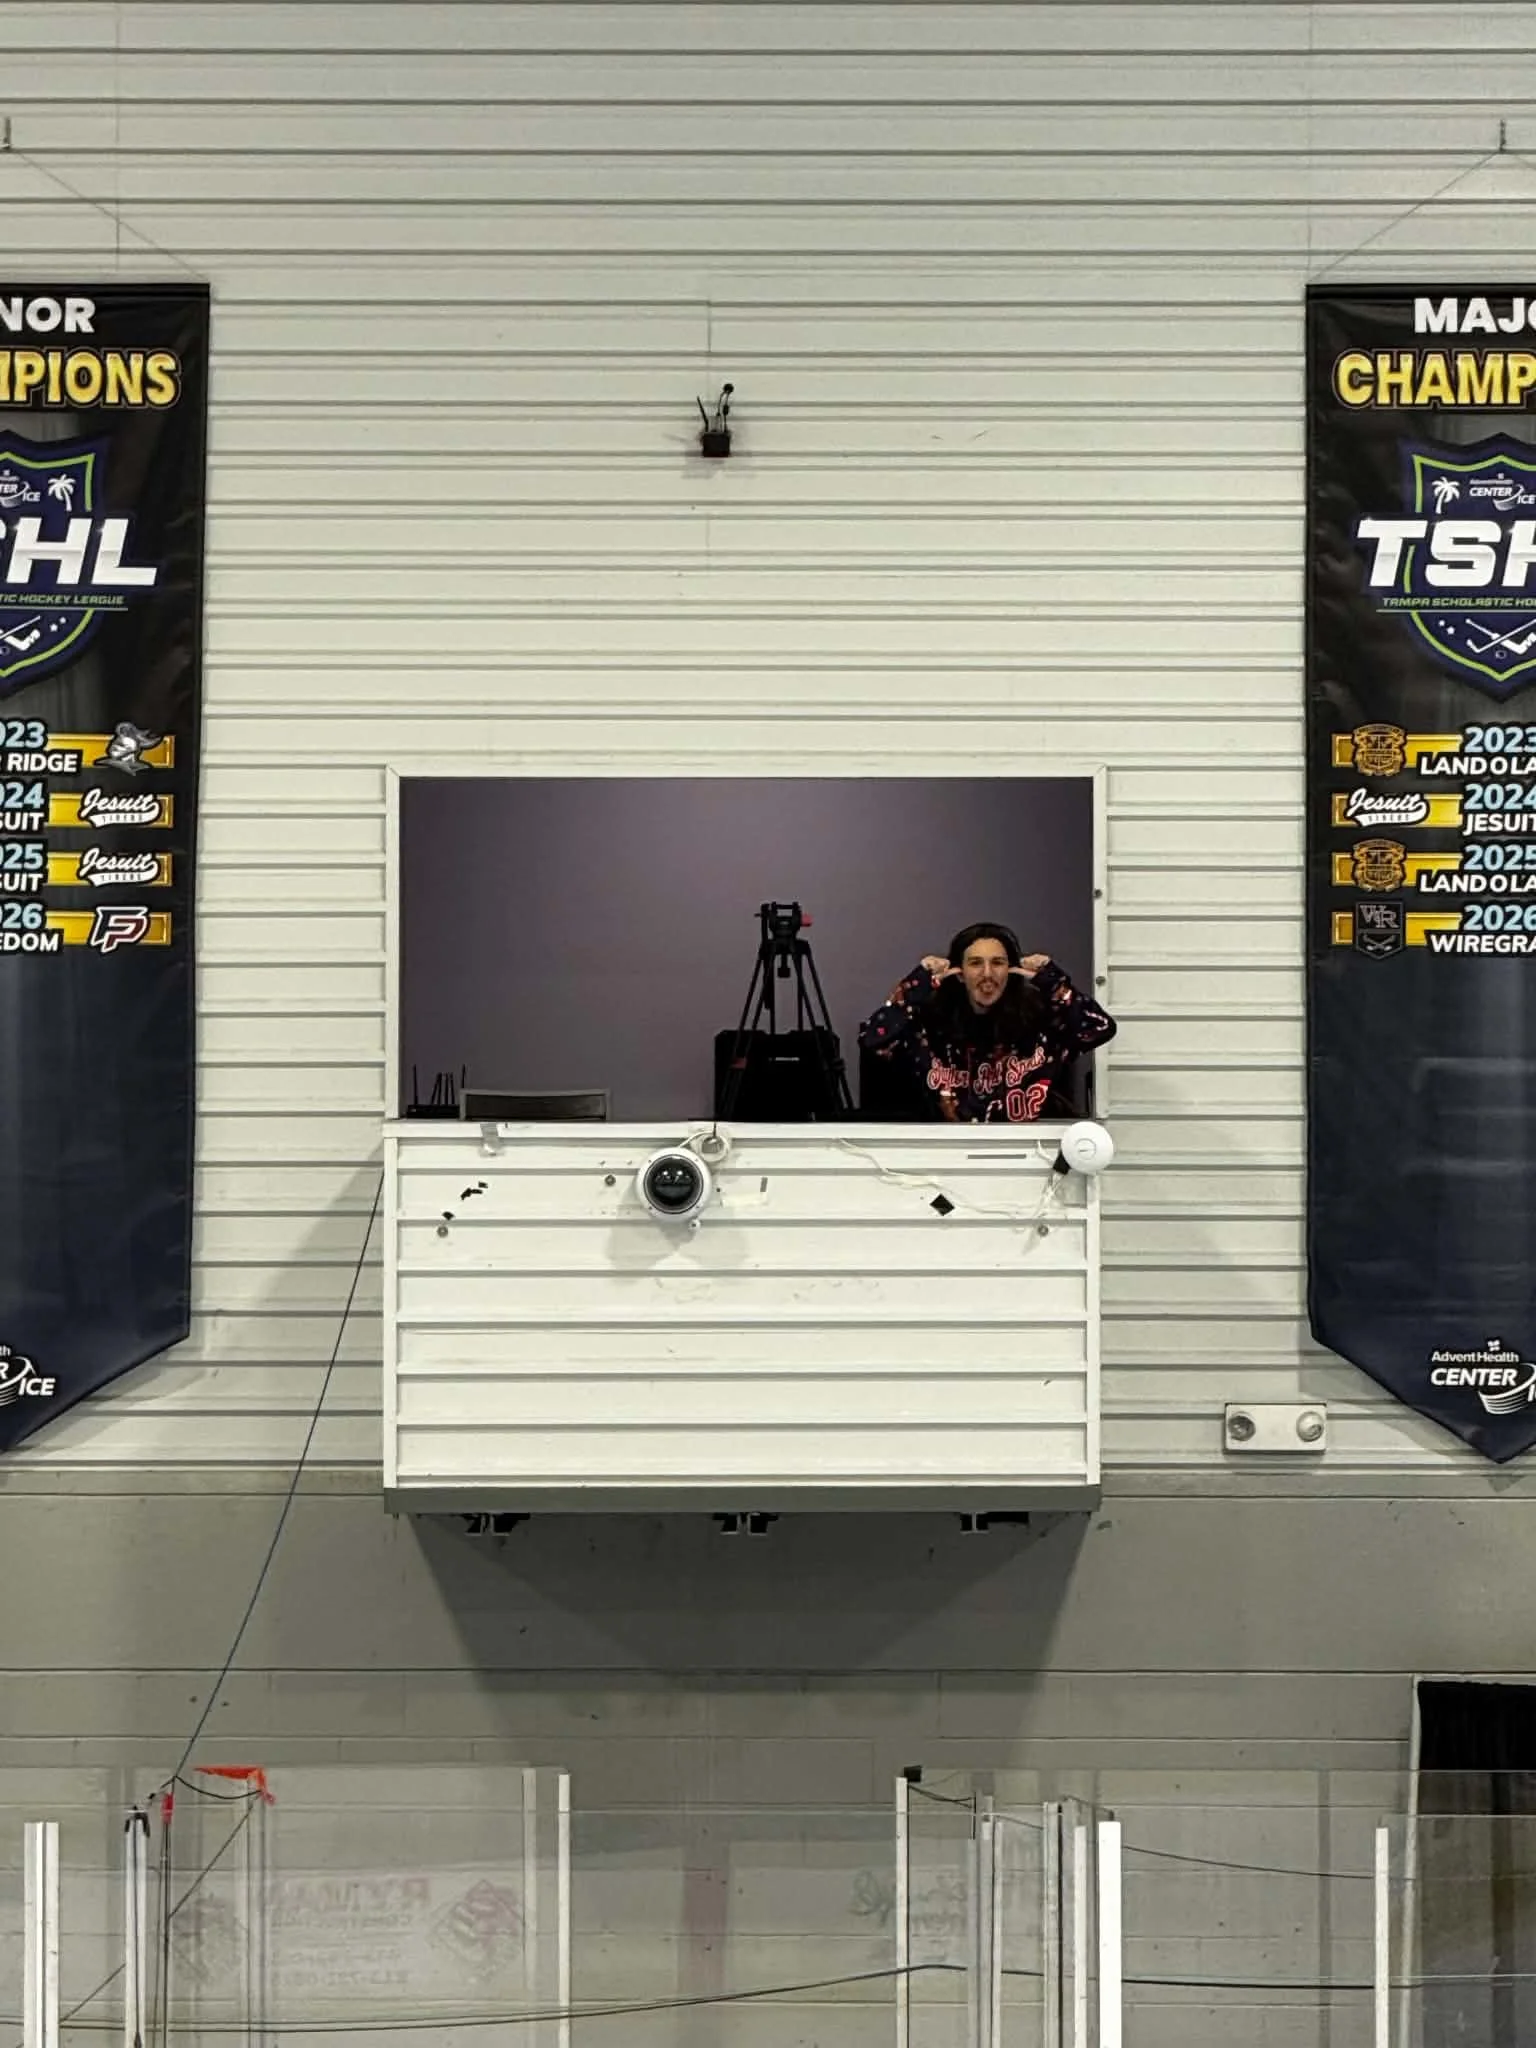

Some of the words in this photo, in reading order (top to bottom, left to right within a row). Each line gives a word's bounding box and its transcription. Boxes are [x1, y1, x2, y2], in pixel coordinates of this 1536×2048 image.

[0, 297, 96, 332] NOR
[1414, 297, 1536, 333] MAJ
[0, 351, 178, 405] PIONS
[1337, 353, 1536, 405] CHAMP
[1470, 487, 1513, 497] CENTER
[1517, 494, 1536, 504] ICE
[0, 517, 157, 586] HL
[18, 594, 71, 604] HOCKEY
[73, 595, 125, 605] LEAGUE
[1382, 597, 1430, 607] TAMPA
[1432, 597, 1514, 607] SCHOLASTIC
[1515, 597, 1536, 607] HO
[1464, 726, 1536, 752] 2023
[8, 753, 78, 772] RIDGE
[1421, 756, 1487, 775] LAND
[0, 782, 44, 808] 24
[80, 788, 153, 817] Jesuit
[1347, 788, 1421, 817] Jesuit
[1464, 783, 1536, 810] 2024
[0, 812, 44, 831] UIT
[0, 843, 43, 869] 25
[79, 847, 152, 877] Jesuit
[1464, 844, 1536, 871] 2025
[0, 873, 43, 892] UIT
[1420, 874, 1487, 893] LAND
[0, 903, 43, 929] 26
[1464, 904, 1536, 931] 2026
[0, 932, 59, 951] DOM
[1432, 1351, 1519, 1362] AdventHealth
[18, 1378, 56, 1396] ICE
[1431, 1368, 1518, 1386] CENTER
